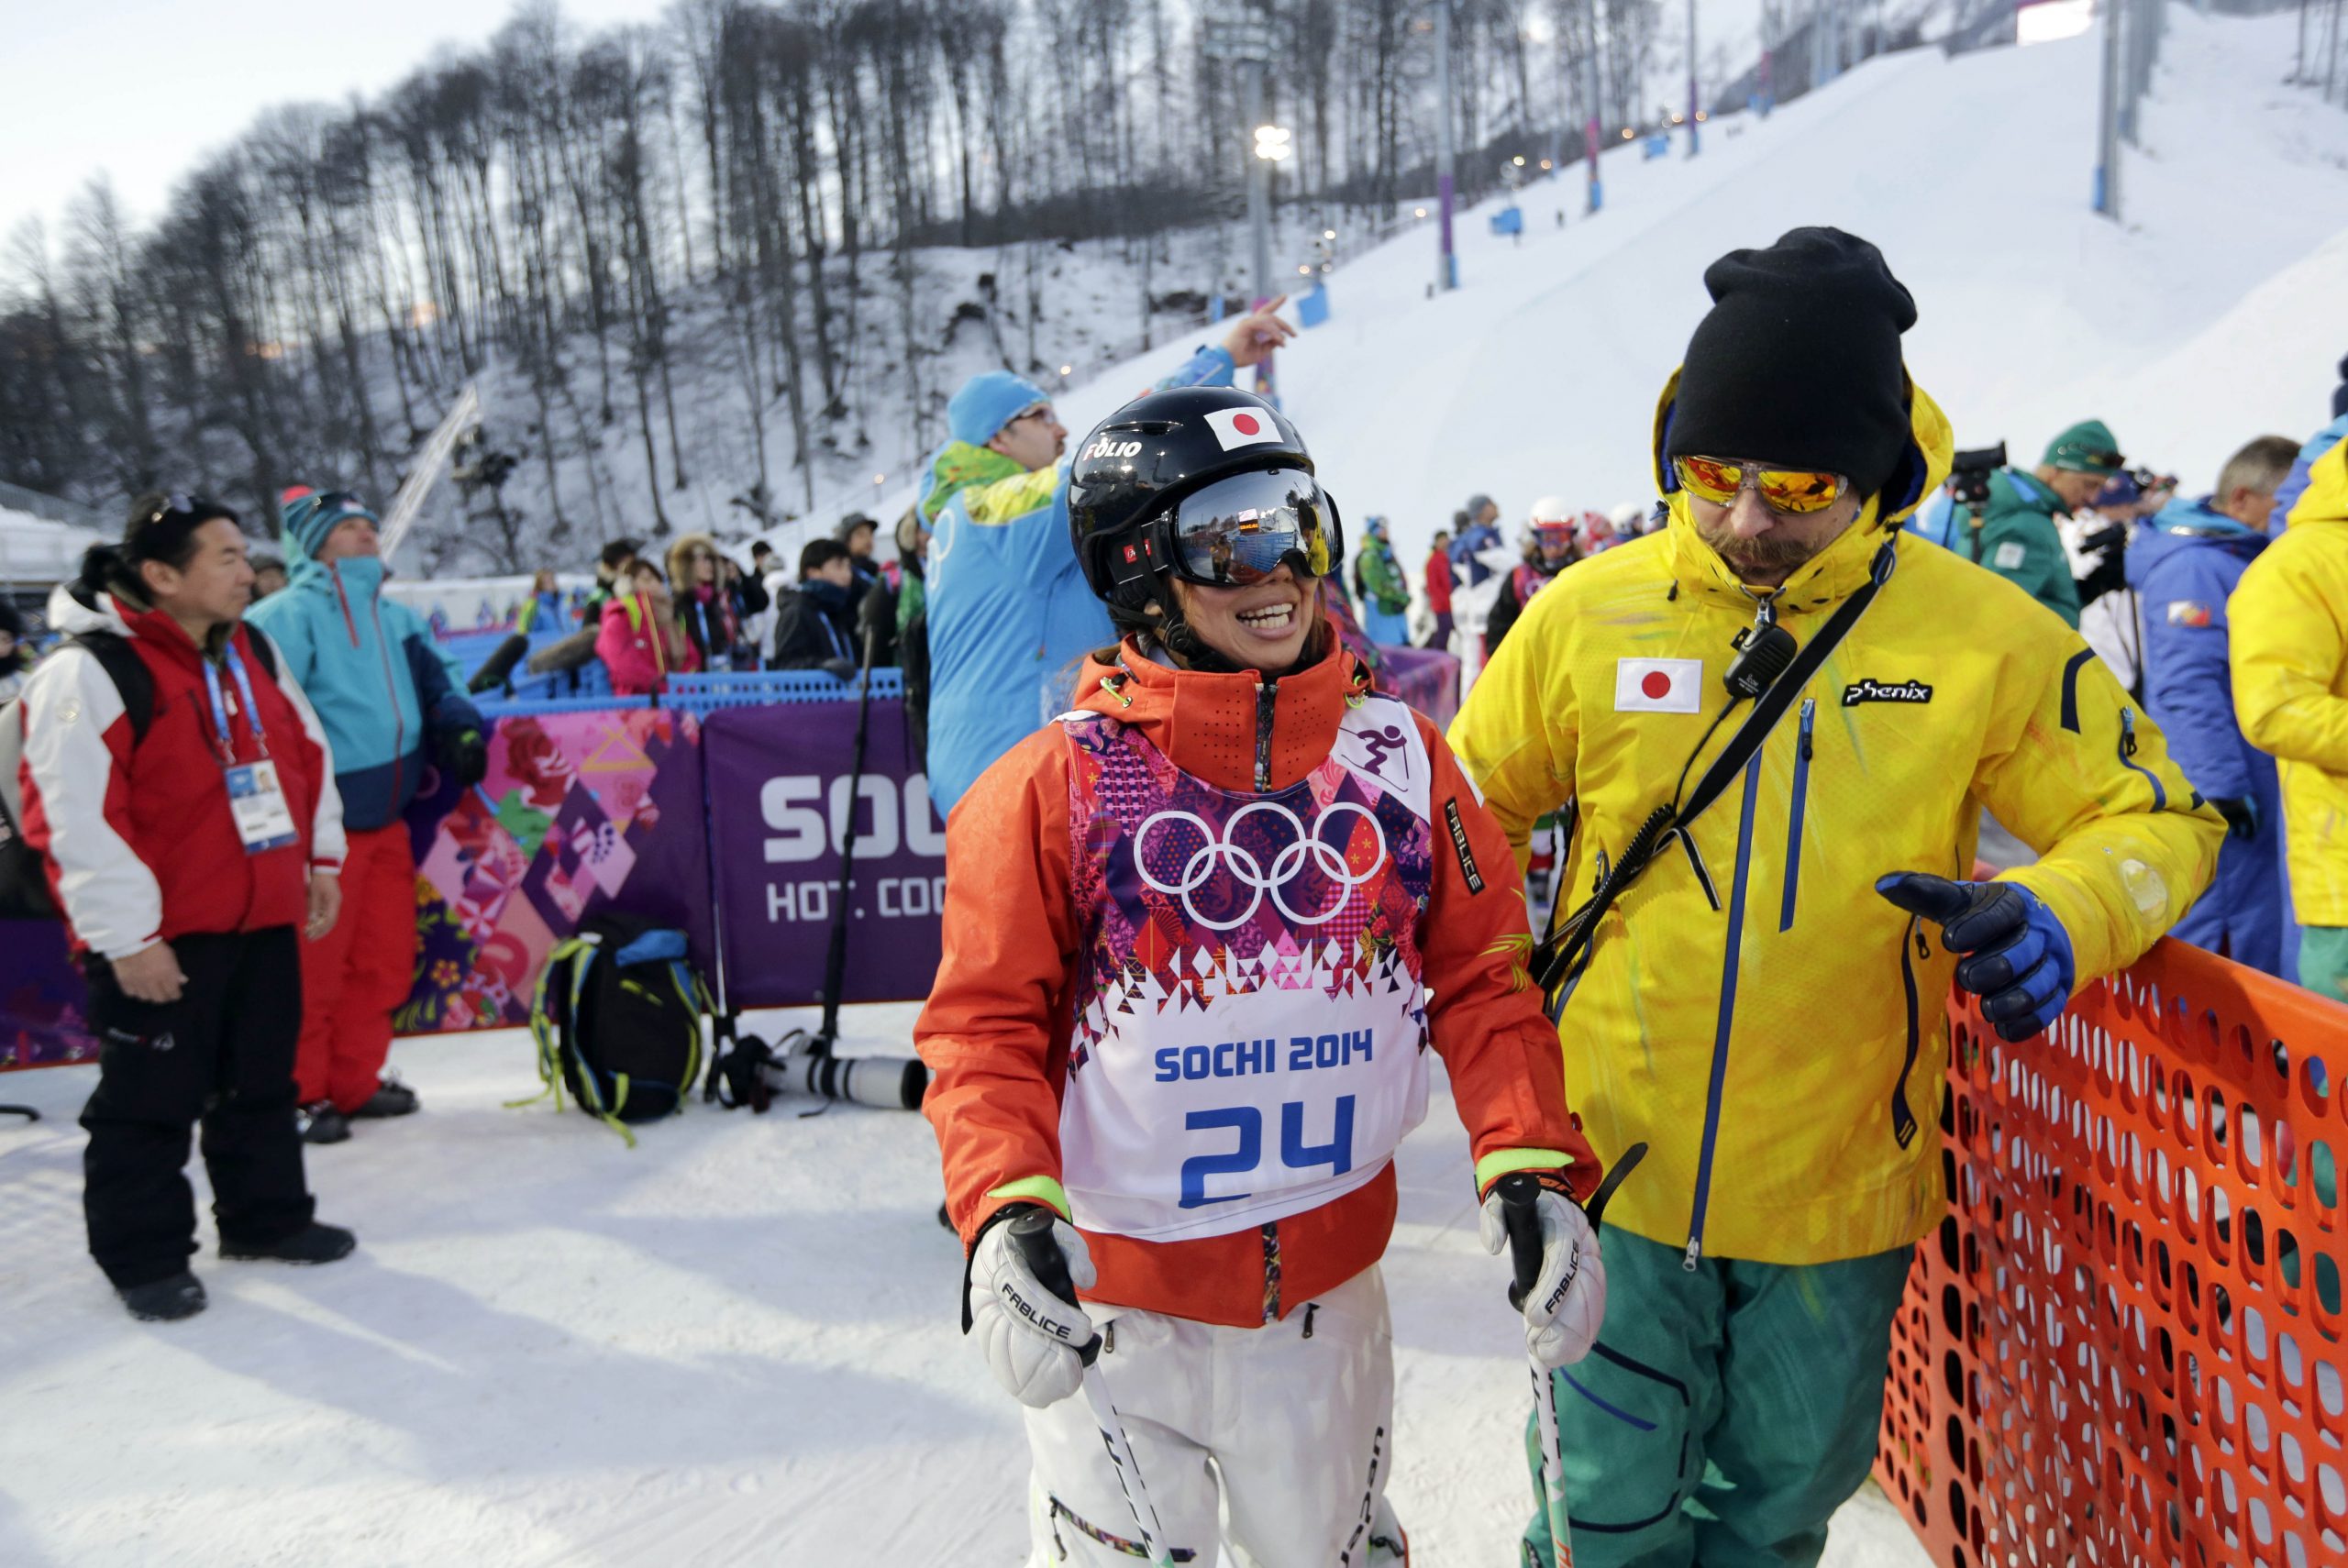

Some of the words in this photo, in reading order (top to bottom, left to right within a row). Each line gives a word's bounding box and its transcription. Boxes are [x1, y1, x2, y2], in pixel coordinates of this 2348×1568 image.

[1082, 441, 1142, 461] FOLIO
[1846, 681, 1928, 703] phenix
[1447, 801, 1481, 890] FABLICE
[1155, 1038, 1276, 1082] SOCHI
[1289, 1028, 1373, 1071] 2014
[1178, 1094, 1356, 1209] 24
[1545, 1239, 1579, 1314] FABLICE
[1002, 1283, 1071, 1340] FABLICE
